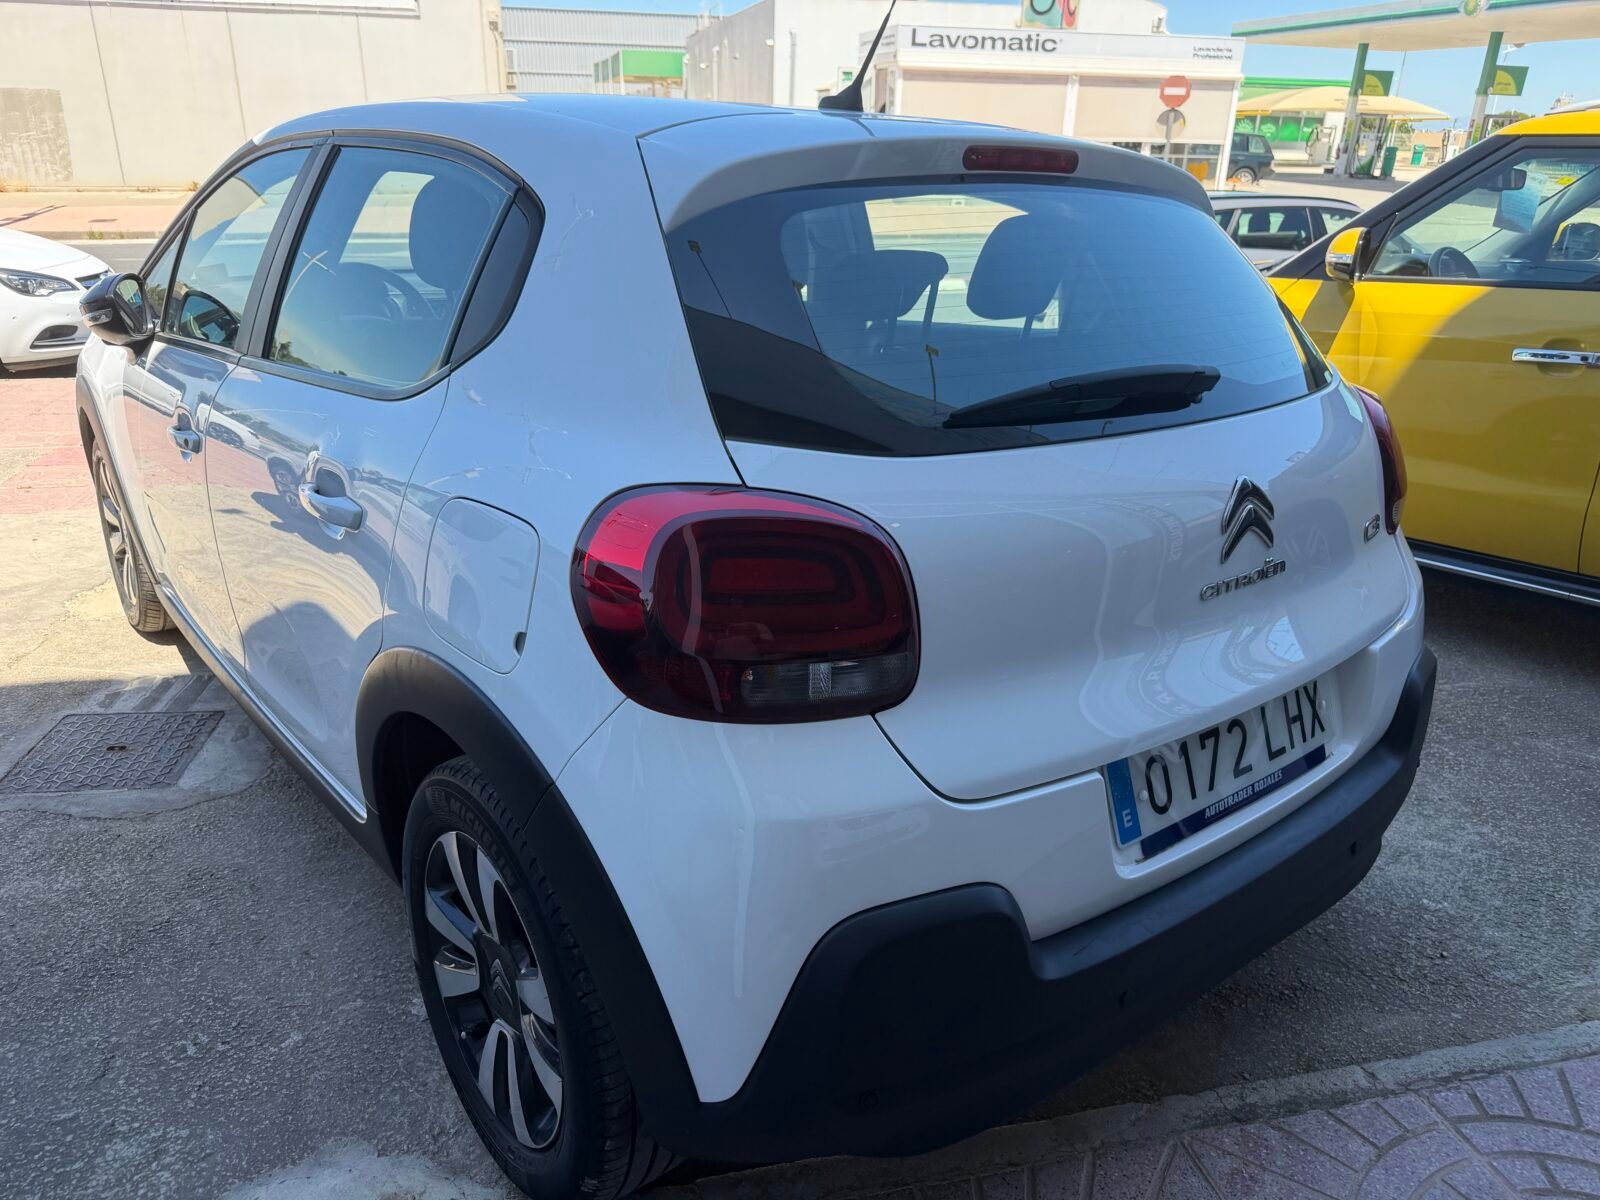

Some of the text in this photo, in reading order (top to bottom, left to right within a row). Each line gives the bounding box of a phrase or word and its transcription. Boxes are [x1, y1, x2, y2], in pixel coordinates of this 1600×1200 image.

[911, 28, 1058, 53] Lavomatic
[1145, 680, 1325, 815] 0172 LHX
[1122, 808, 1133, 828] E
[1204, 785, 1254, 819] AUTOTRADER
[449, 798, 520, 891] MICHELIN
